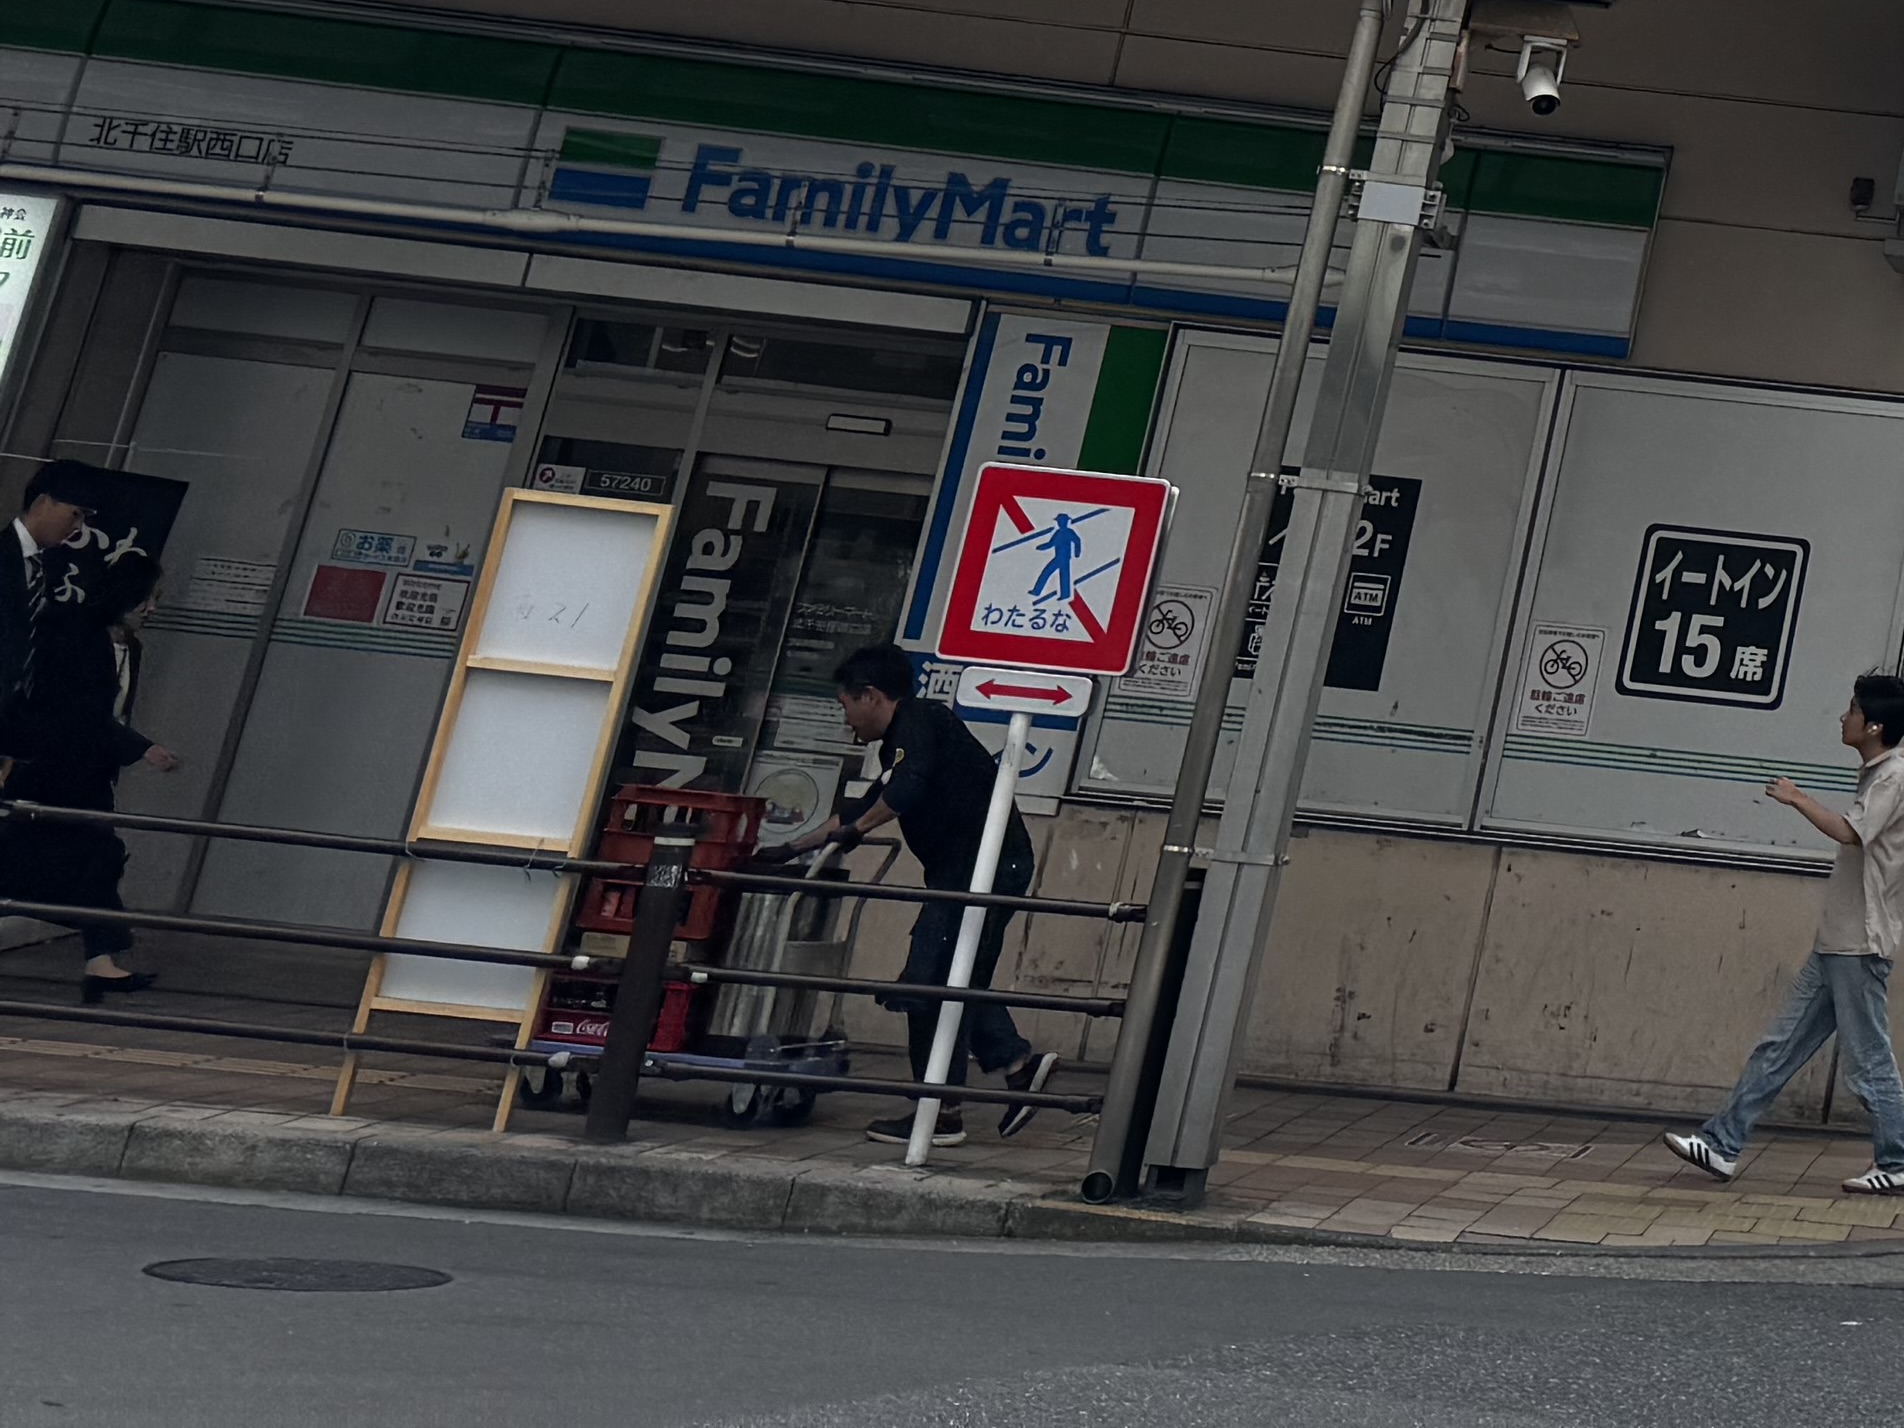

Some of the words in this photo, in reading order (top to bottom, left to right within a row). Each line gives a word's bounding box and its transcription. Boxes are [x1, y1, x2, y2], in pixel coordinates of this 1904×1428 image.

[89, 117, 293, 167] 北千住駅西口店
[681, 145, 1118, 257] FamilyMart
[599, 472, 653, 493] 57240
[1353, 519, 1393, 557] 2F
[1654, 550, 1787, 610] イートイン
[980, 603, 1073, 633] わたるな
[1654, 611, 1769, 684] 15席
[1138, 664, 1182, 677] ください
